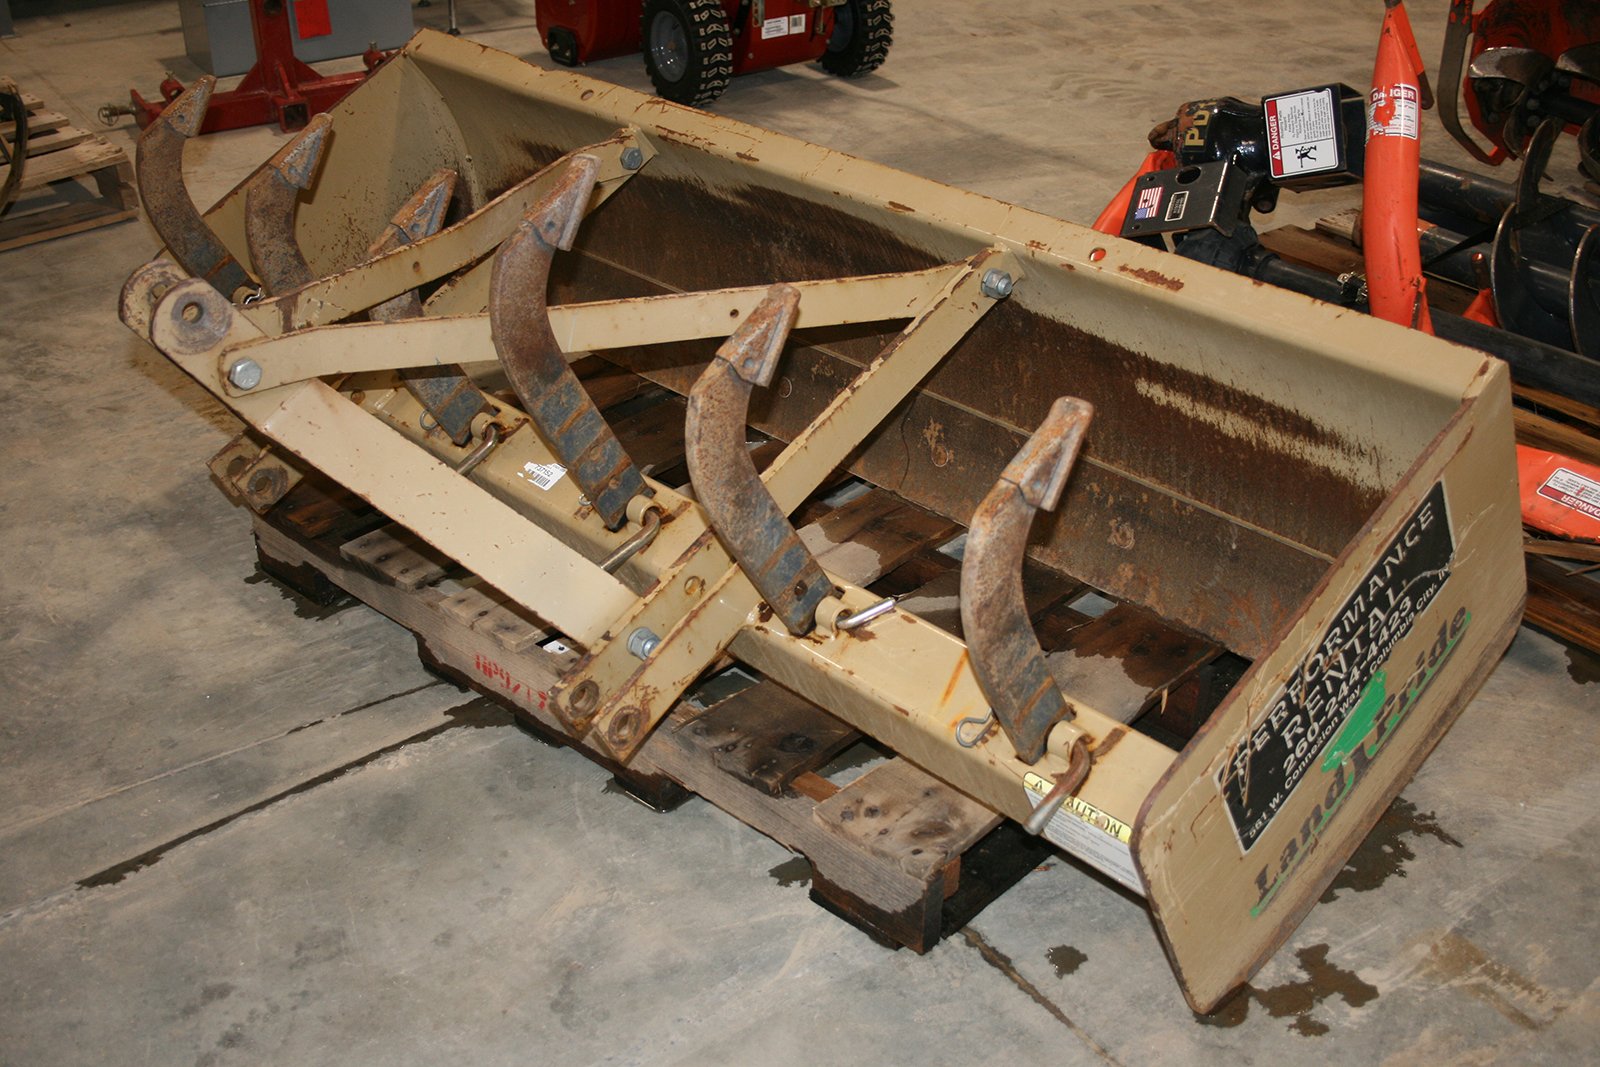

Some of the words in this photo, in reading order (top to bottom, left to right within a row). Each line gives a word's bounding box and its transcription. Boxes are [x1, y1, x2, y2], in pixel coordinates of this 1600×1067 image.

[1269, 115, 1280, 151] DANGER
[1231, 500, 1434, 779] PERFORMANCE
[1269, 788, 1284, 811] W.
[1339, 682, 1362, 717] Way
[1368, 608, 1414, 676] Columbia
[1280, 569, 1408, 754] RENTAL
[1281, 592, 1412, 777] 260-244-4423
[1252, 762, 1351, 905] Land
[1367, 602, 1471, 743] Pride
